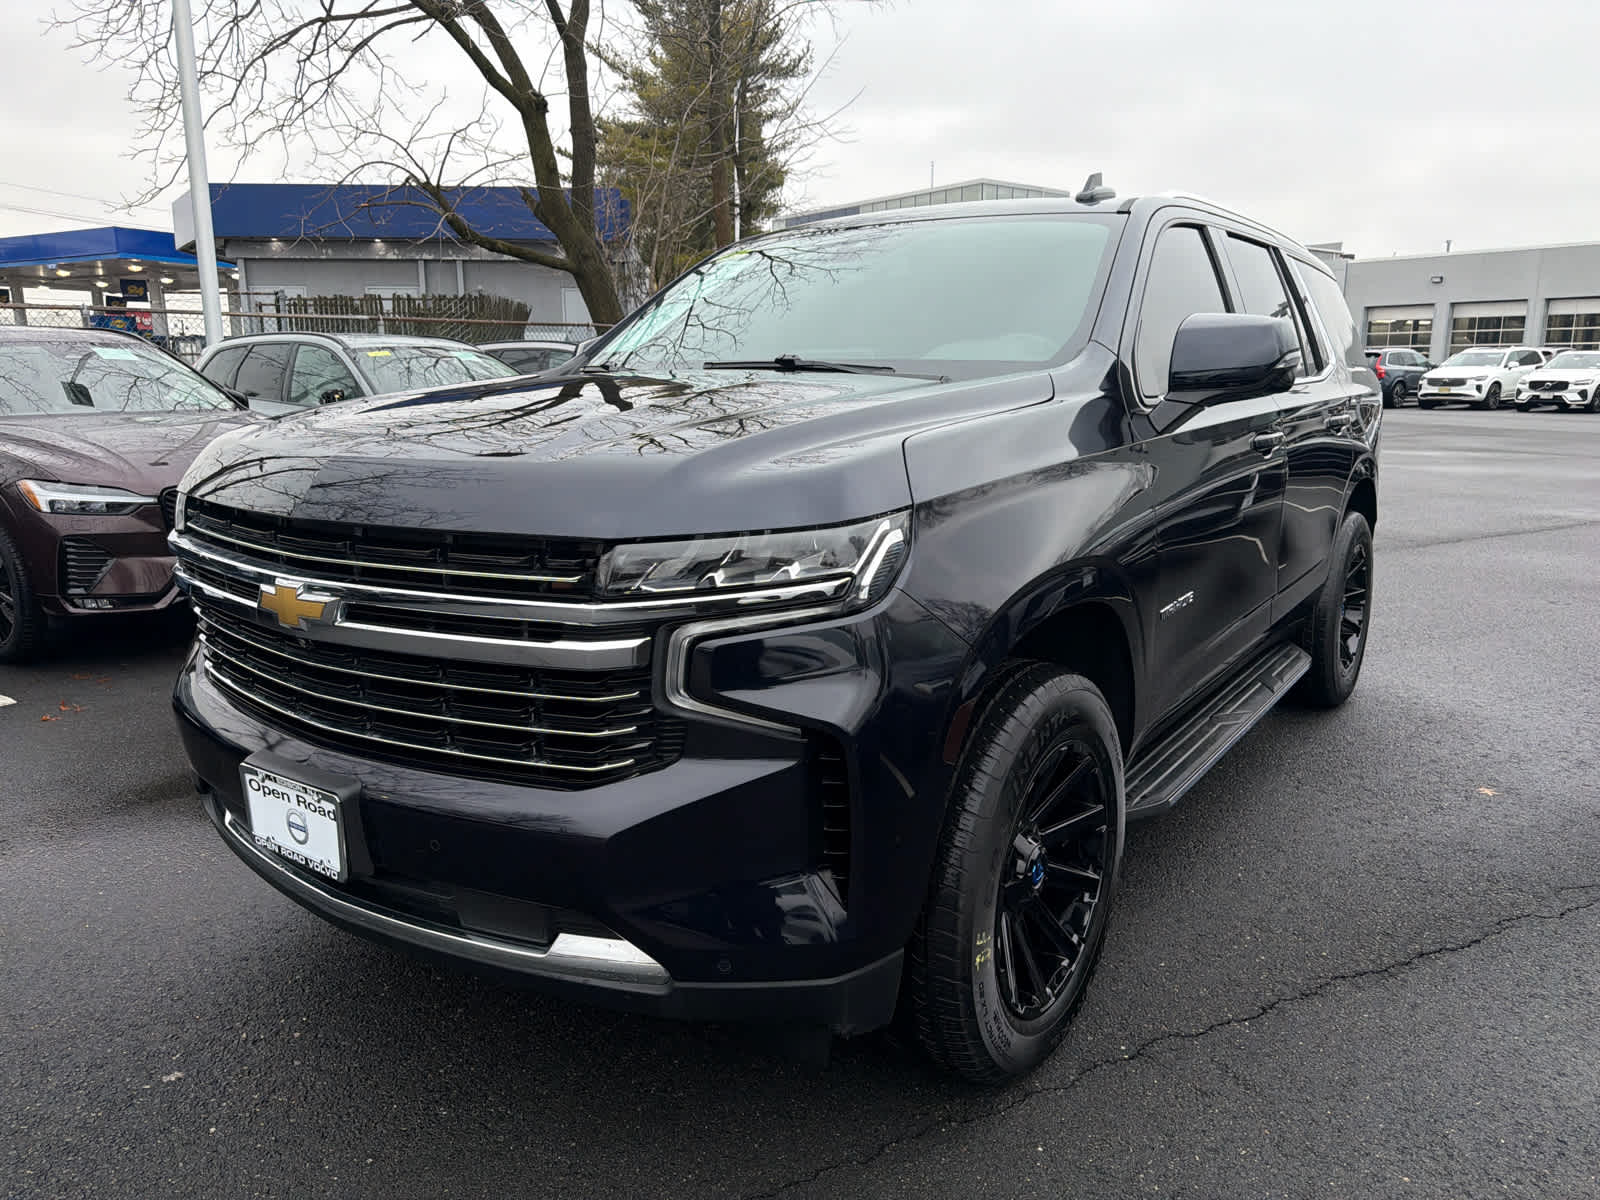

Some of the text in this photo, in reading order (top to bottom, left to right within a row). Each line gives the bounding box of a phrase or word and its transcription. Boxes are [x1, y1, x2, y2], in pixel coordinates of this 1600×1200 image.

[248, 778, 292, 804] Open
[296, 794, 337, 822] Road
[255, 836, 338, 880] OPEN ROAD VOLVO
